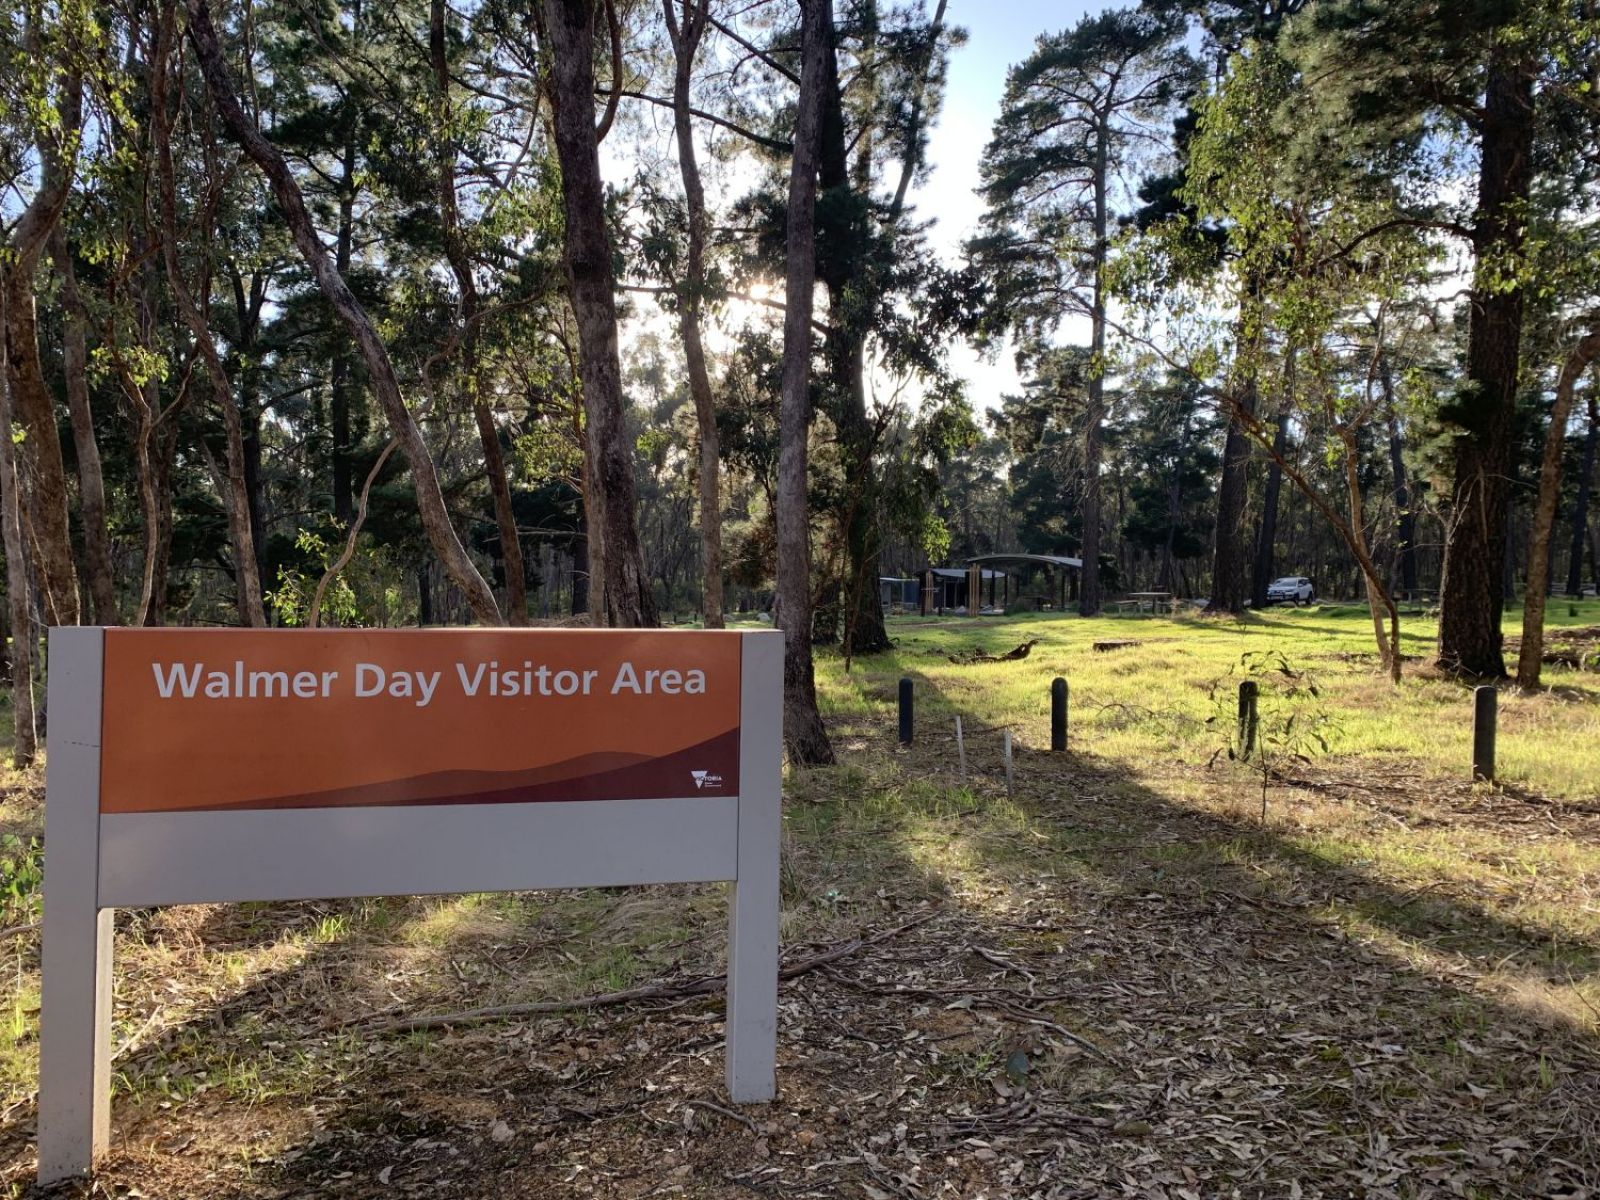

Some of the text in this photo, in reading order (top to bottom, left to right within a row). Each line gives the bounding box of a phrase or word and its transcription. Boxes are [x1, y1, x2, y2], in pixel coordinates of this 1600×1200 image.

[152, 660, 706, 707] Walmer Day Visitor Area
